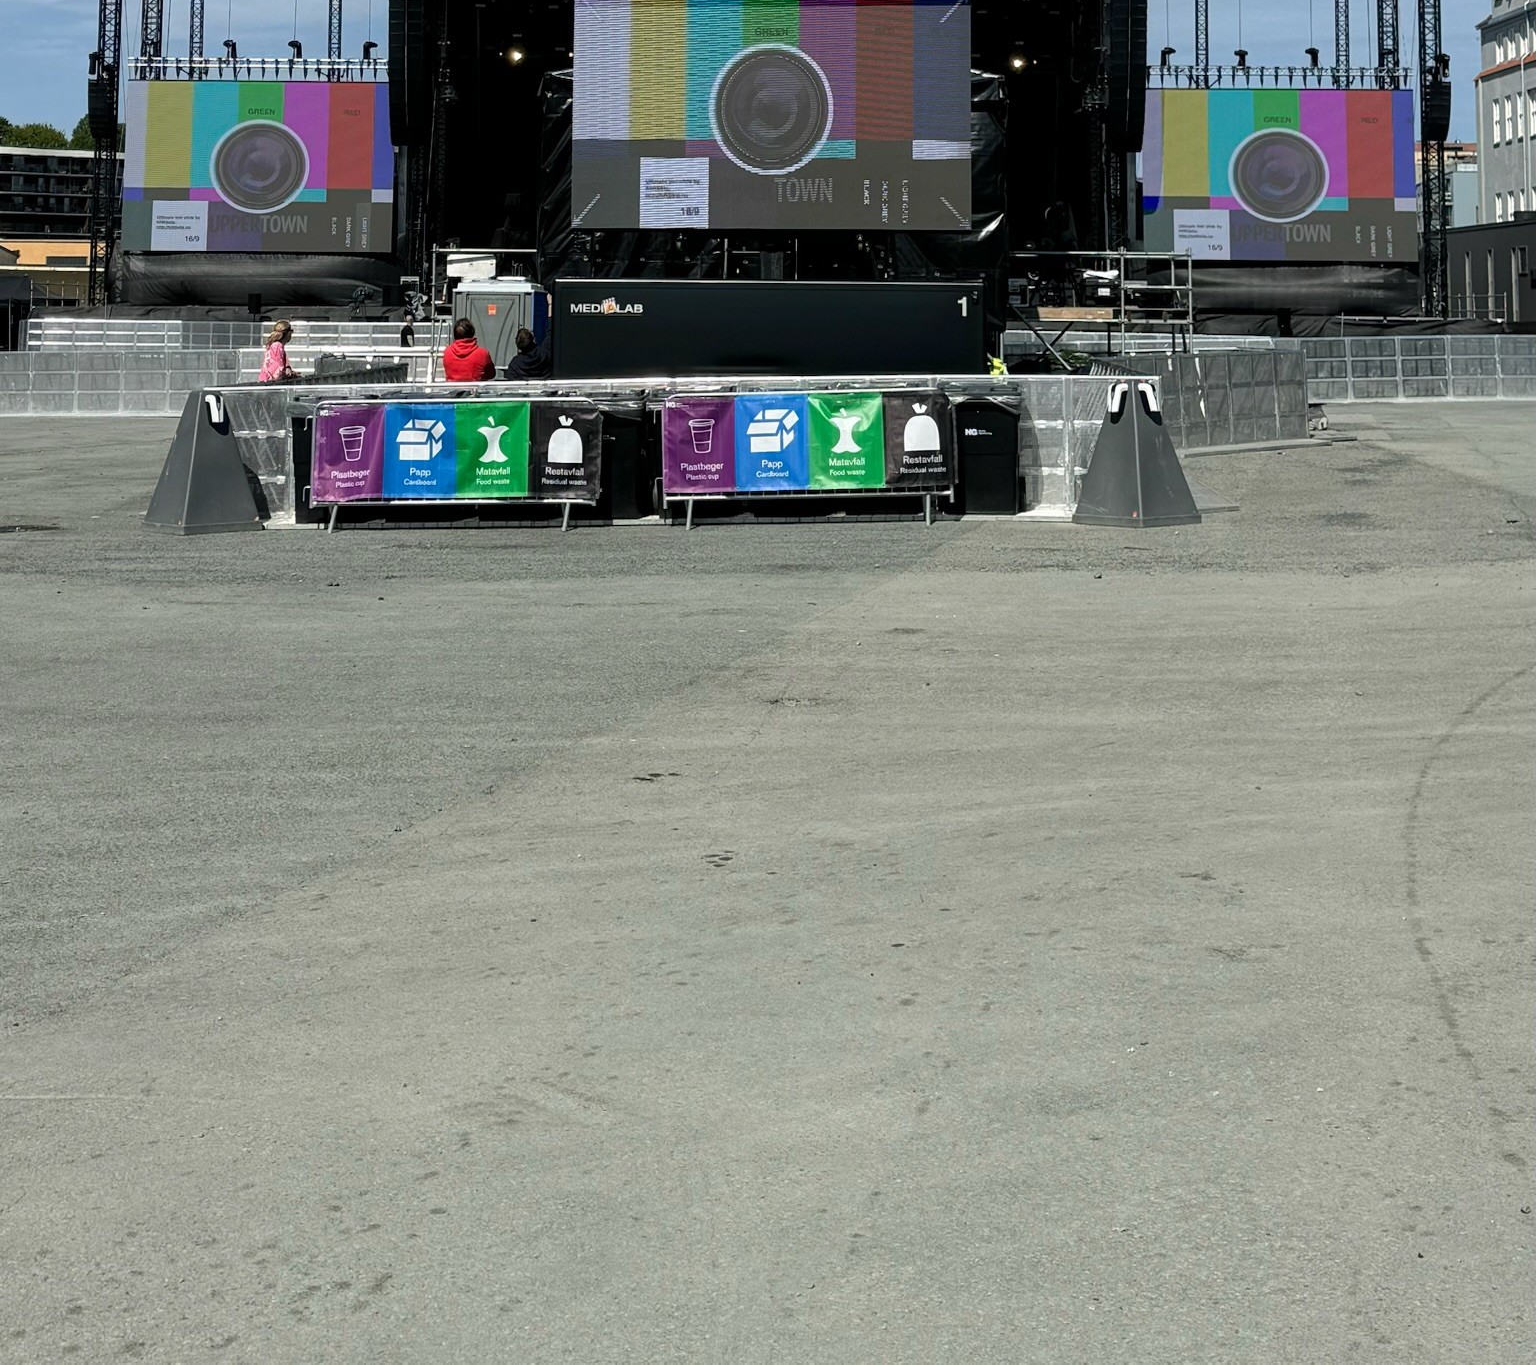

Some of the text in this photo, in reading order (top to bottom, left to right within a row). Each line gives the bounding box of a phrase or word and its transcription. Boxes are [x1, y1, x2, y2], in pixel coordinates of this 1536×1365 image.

[754, 27, 789, 36] GREEN
[247, 108, 276, 116] GREEN
[1263, 116, 1292, 124] GREEN
[957, 296, 967, 317] 1
[761, 459, 784, 469] Papp
[828, 457, 866, 466] Matavfall
[902, 454, 943, 464] Restavfall
[409, 467, 432, 477] Papp
[475, 467, 511, 476] Matavfall
[544, 466, 585, 477] Restavfall
[680, 462, 724, 472] Plastbeger
[900, 466, 927, 474] Residual
[330, 468, 371, 479] Plastbeger
